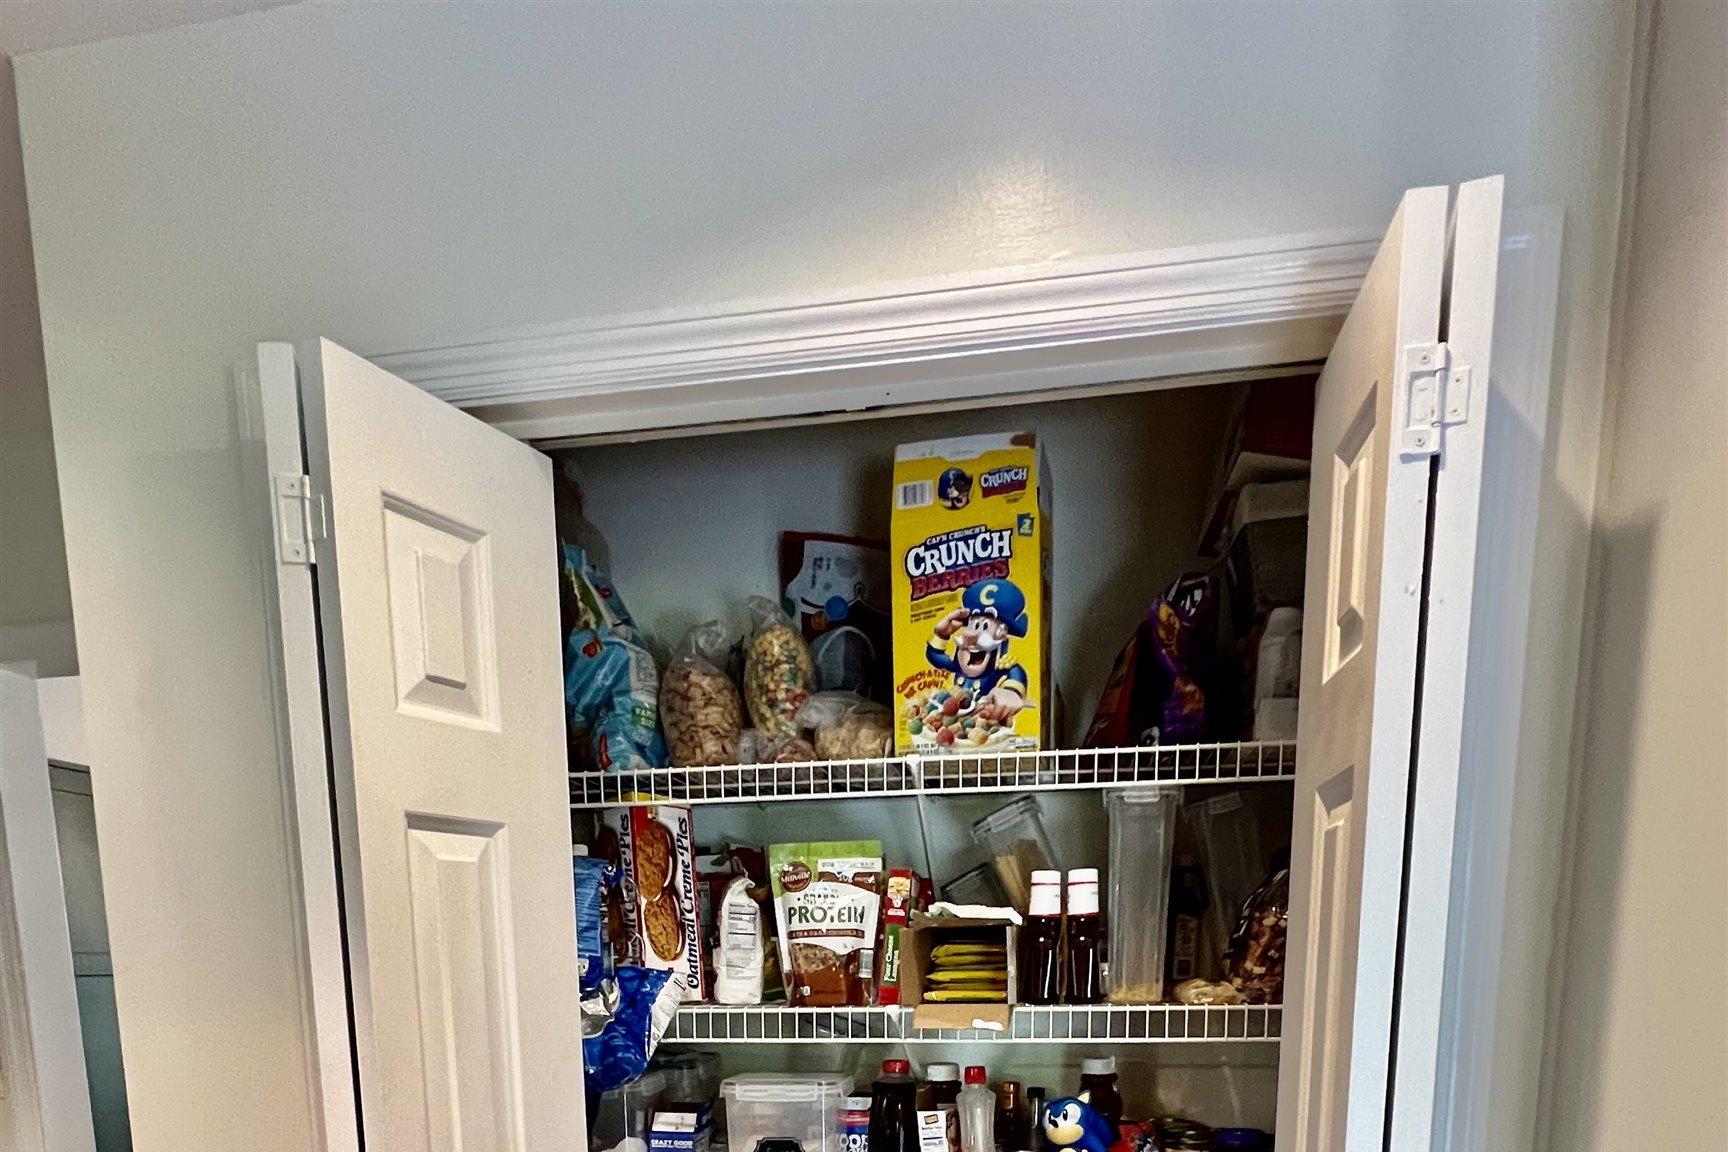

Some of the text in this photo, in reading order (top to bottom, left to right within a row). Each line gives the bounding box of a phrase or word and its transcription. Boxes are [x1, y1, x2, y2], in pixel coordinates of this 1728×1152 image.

[980, 468, 1027, 488] CRUNCH
[906, 530, 1011, 577] CRUNCH
[911, 558, 1010, 600] BERRIES
[677, 816, 700, 990] Oatmeal Creme Pies
